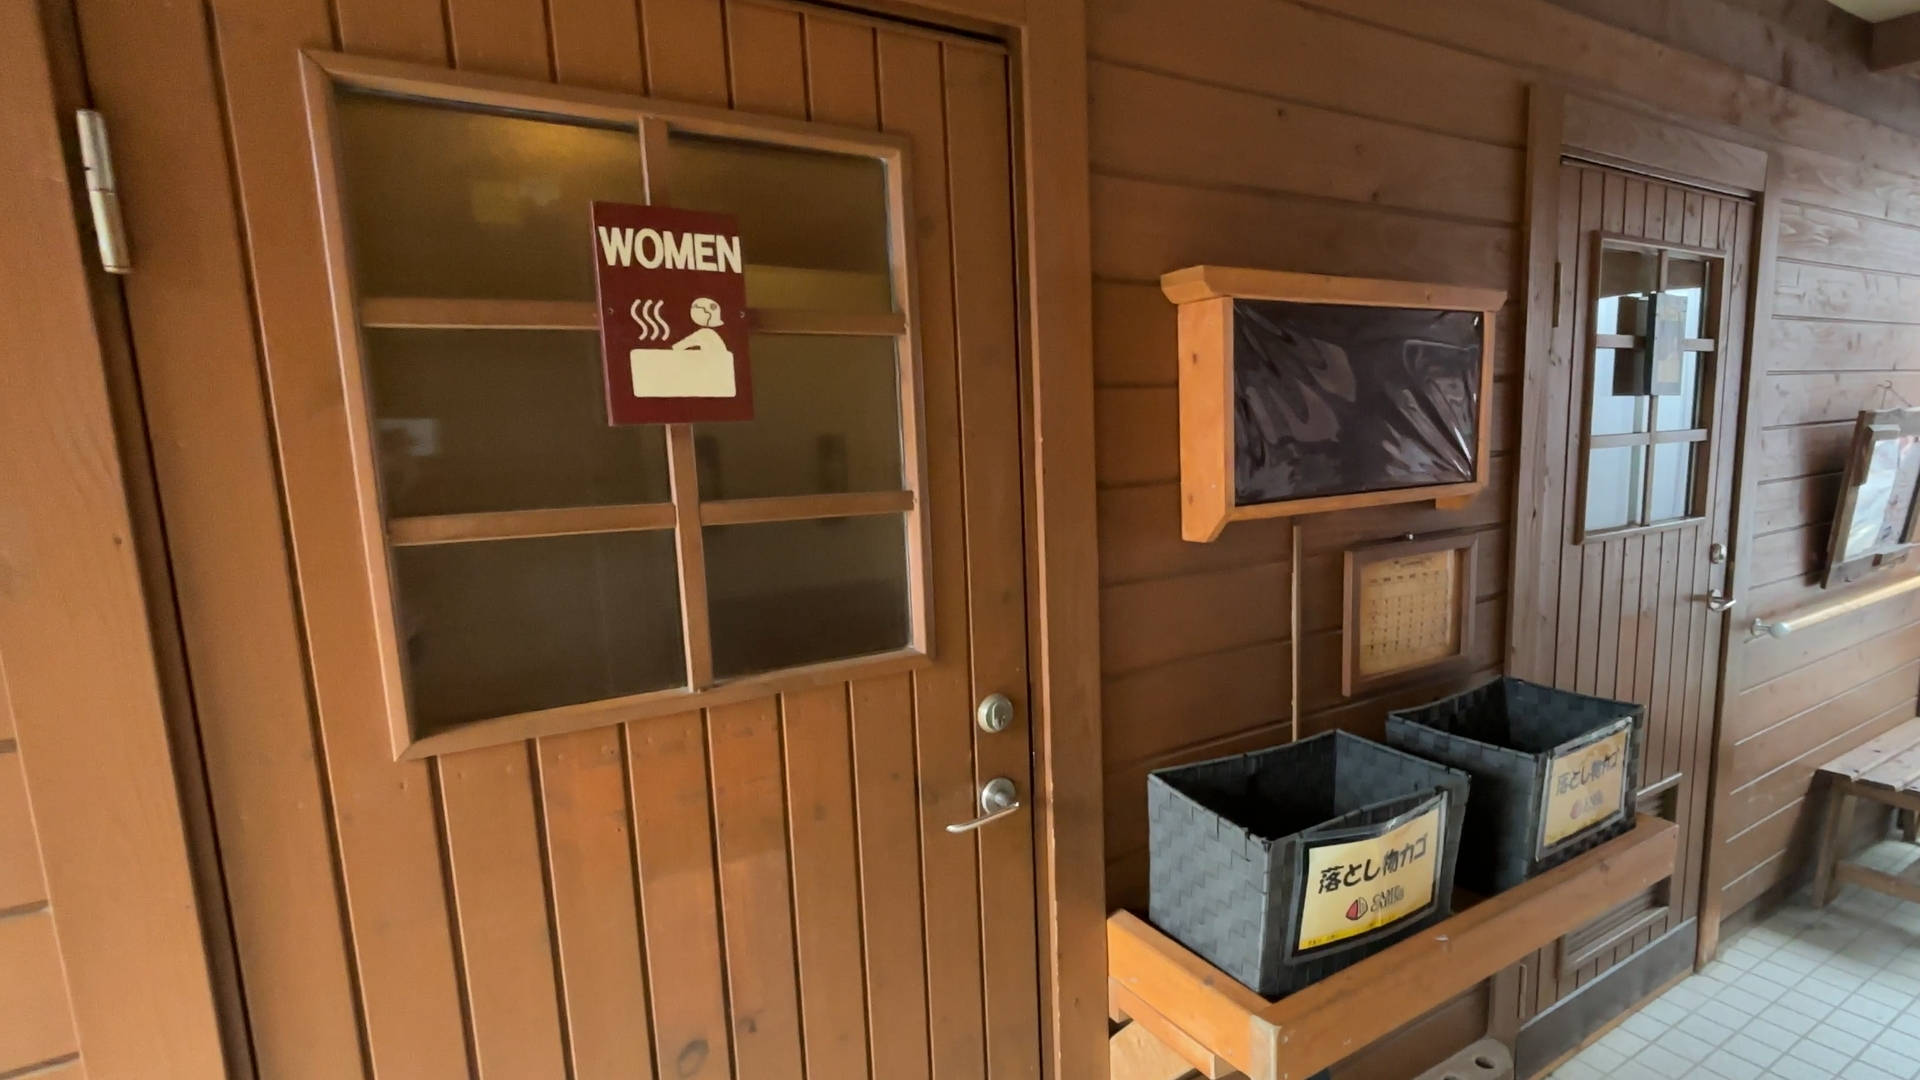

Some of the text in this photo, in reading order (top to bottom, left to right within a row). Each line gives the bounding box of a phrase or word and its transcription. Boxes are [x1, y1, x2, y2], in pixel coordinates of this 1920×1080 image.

[598, 226, 742, 274] WOMEN
[1318, 833, 1428, 894] 落とし物カゴ
